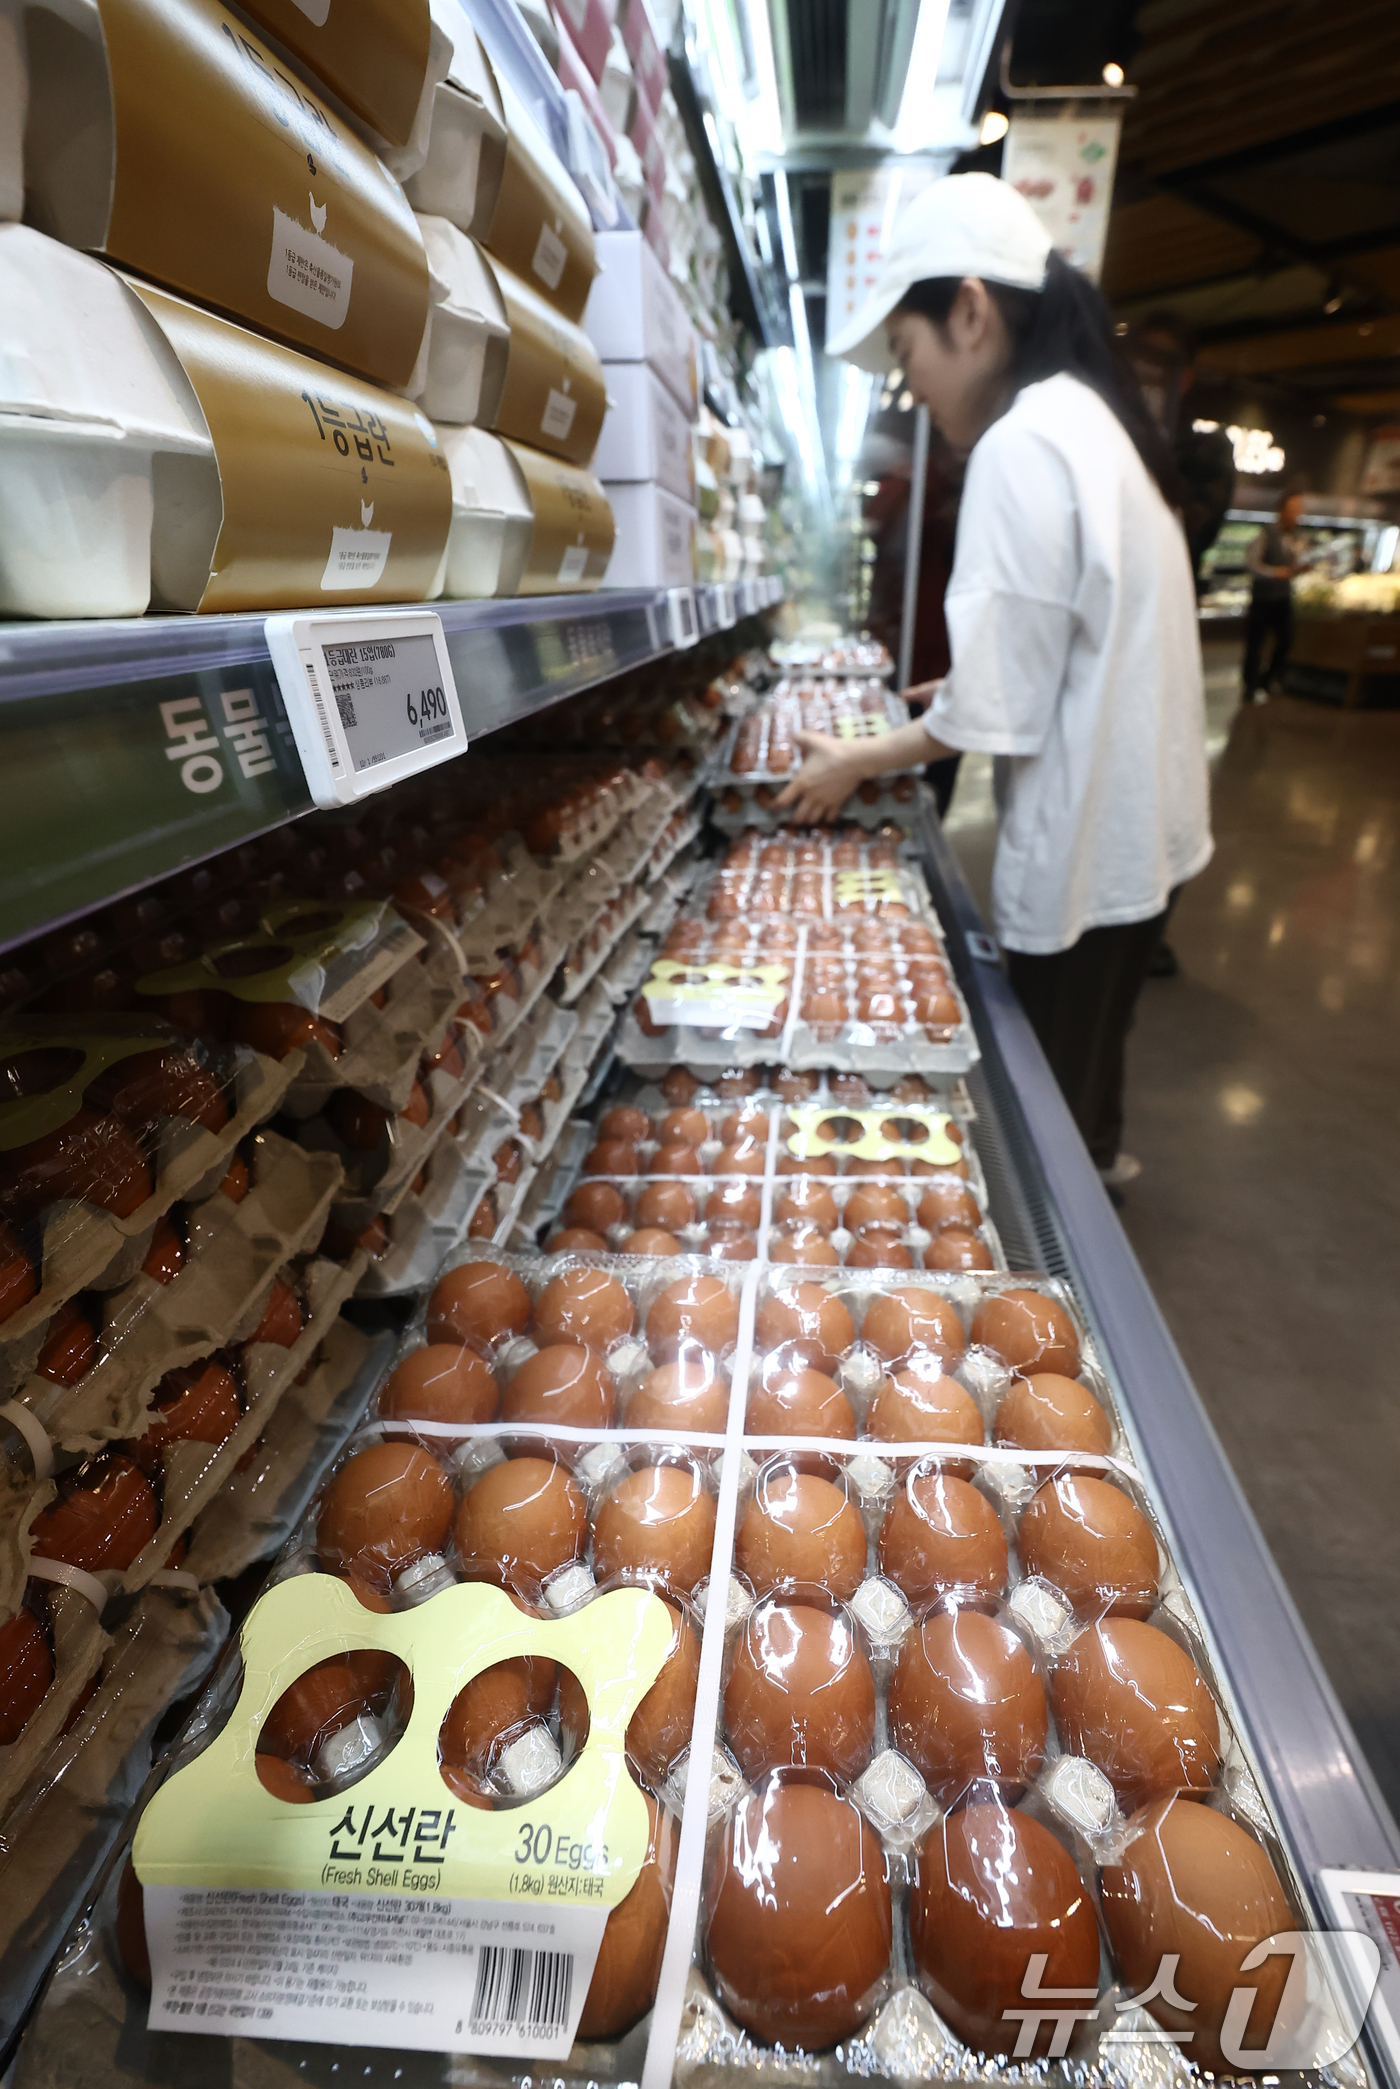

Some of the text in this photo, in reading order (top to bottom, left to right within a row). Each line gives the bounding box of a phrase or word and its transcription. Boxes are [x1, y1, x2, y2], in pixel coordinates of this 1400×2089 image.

[301, 389, 395, 467] 1등급란
[407, 687, 447, 728] 6,490
[329, 1805, 456, 1863] 신선란
[514, 1823, 609, 1870] 30 Eggs
[321, 1863, 441, 1891] (Fresh Shell Eggs)
[548, 1874, 604, 1898] 원산지:태국
[455, 2019, 559, 2040] 8 809797 610001
